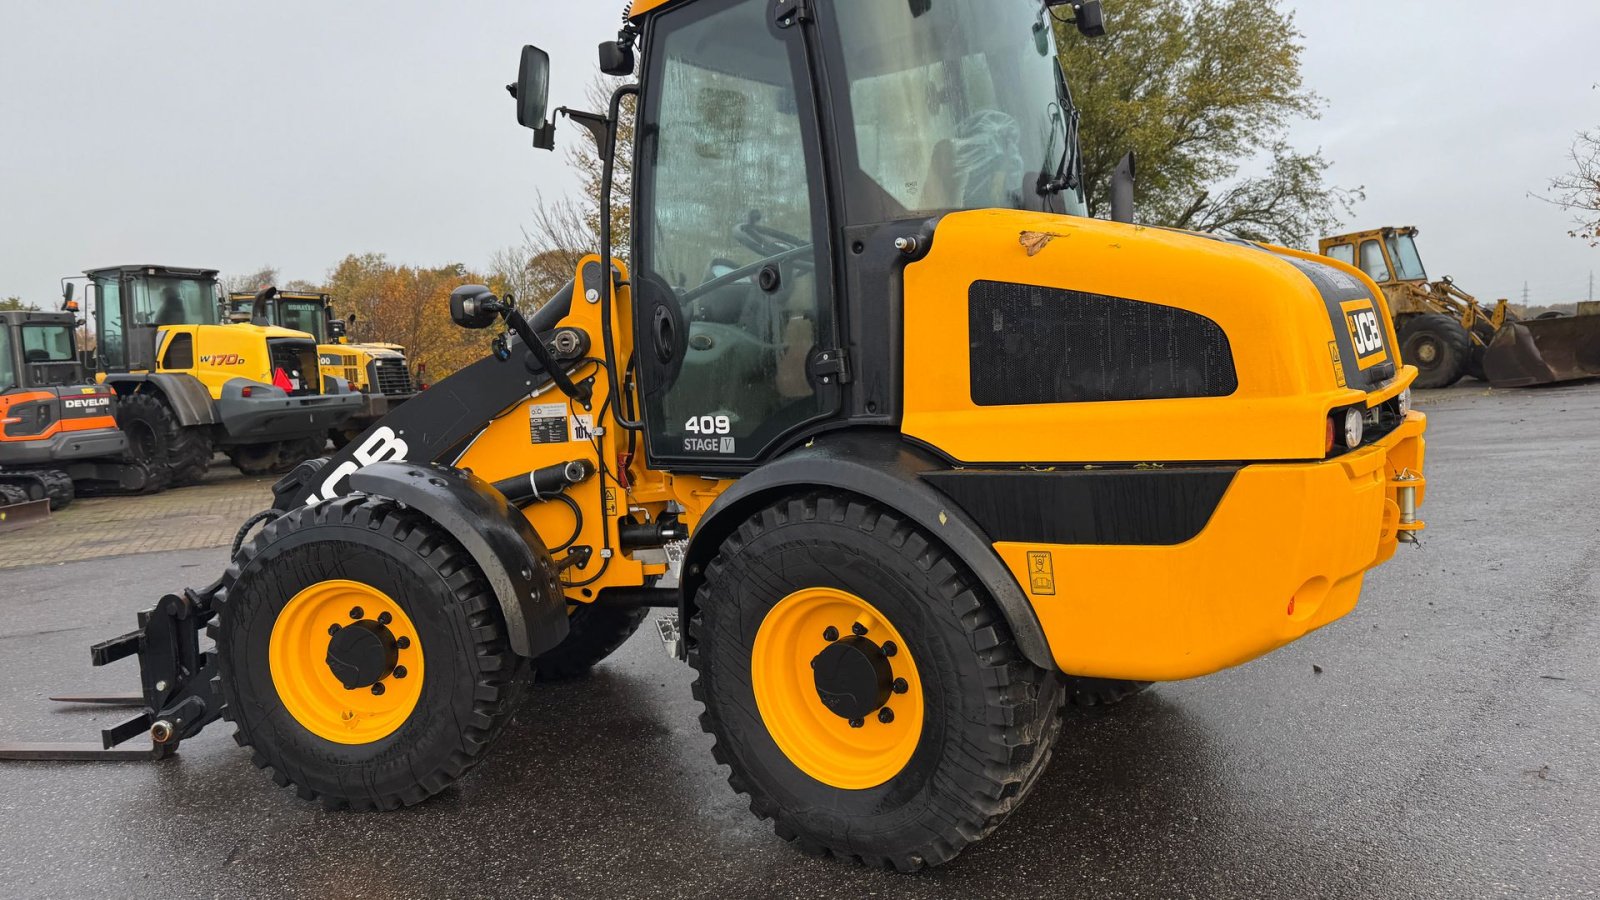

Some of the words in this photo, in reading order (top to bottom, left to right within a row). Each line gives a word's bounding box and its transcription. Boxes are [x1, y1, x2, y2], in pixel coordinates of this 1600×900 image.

[1353, 311, 1382, 354] JCB
[65, 398, 110, 408] DEVELON
[685, 415, 730, 434] 409
[684, 438, 719, 451] STAGE
[722, 437, 734, 452] V
[305, 426, 409, 506] CB
